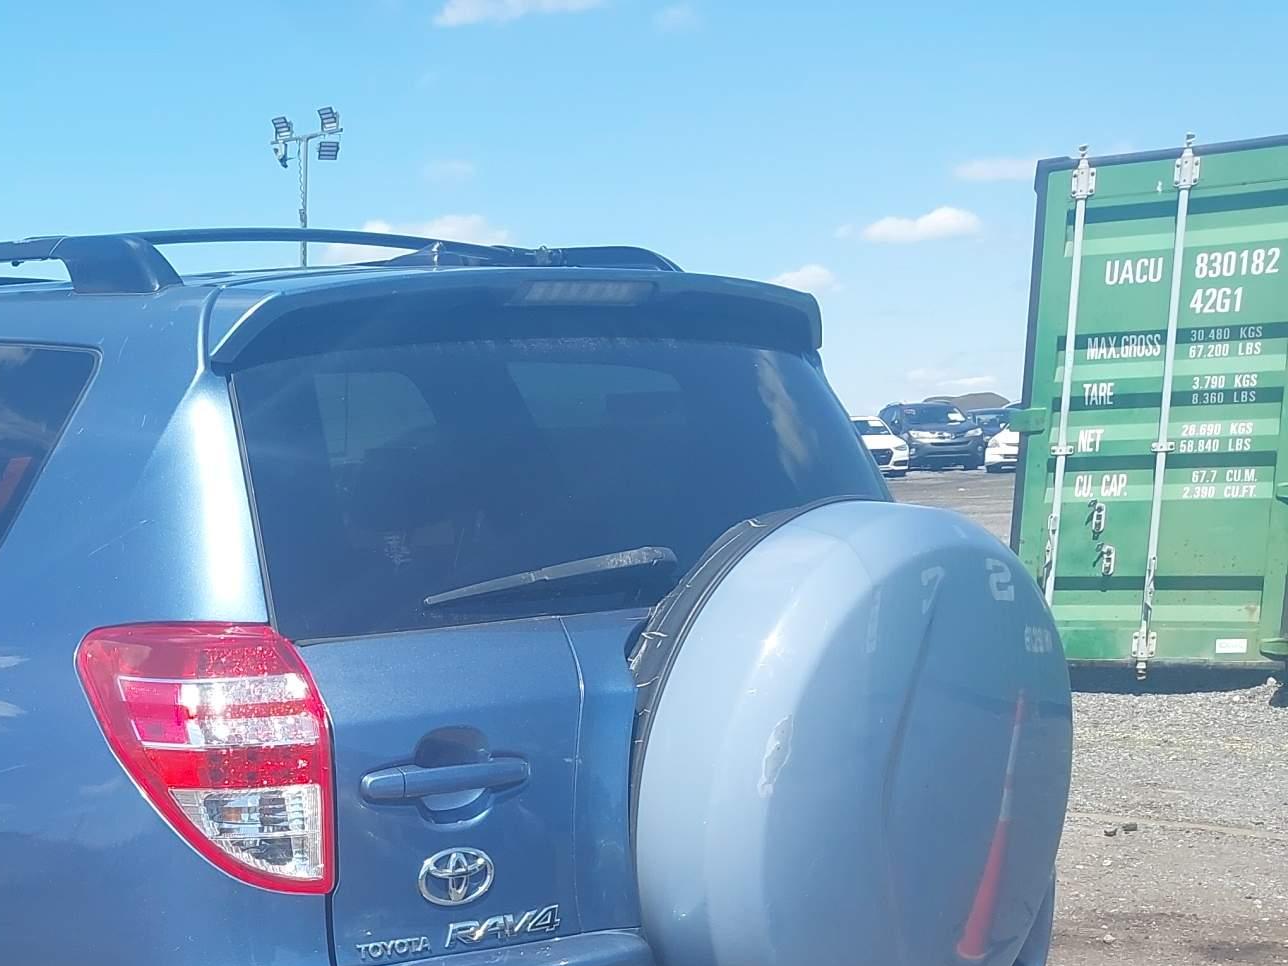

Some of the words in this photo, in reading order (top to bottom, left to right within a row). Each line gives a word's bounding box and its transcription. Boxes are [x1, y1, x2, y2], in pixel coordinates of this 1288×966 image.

[1105, 257, 1163, 285] UACU
[1195, 247, 1280, 279] 830182
[1190, 287, 1243, 314] 42G1
[1190, 328, 1230, 342] 30.480
[1240, 325, 1263, 338] KGS
[1189, 344, 1229, 358] 67.200
[1238, 342, 1262, 356] LBS
[1192, 375, 1225, 389] 3.790
[1234, 374, 1258, 388] KGS
[1082, 382, 1115, 406] TARE
[1192, 391, 1224, 404] 8.360
[1234, 390, 1256, 403] LBS
[1229, 422, 1254, 435] KGS
[1077, 429, 1104, 453] NET
[1228, 438, 1252, 451] LBS
[1074, 475, 1094, 498] CU.
[1101, 474, 1128, 497] CAP.
[356, 936, 432, 962] TOYOTA
[445, 904, 560, 948] RAV4
